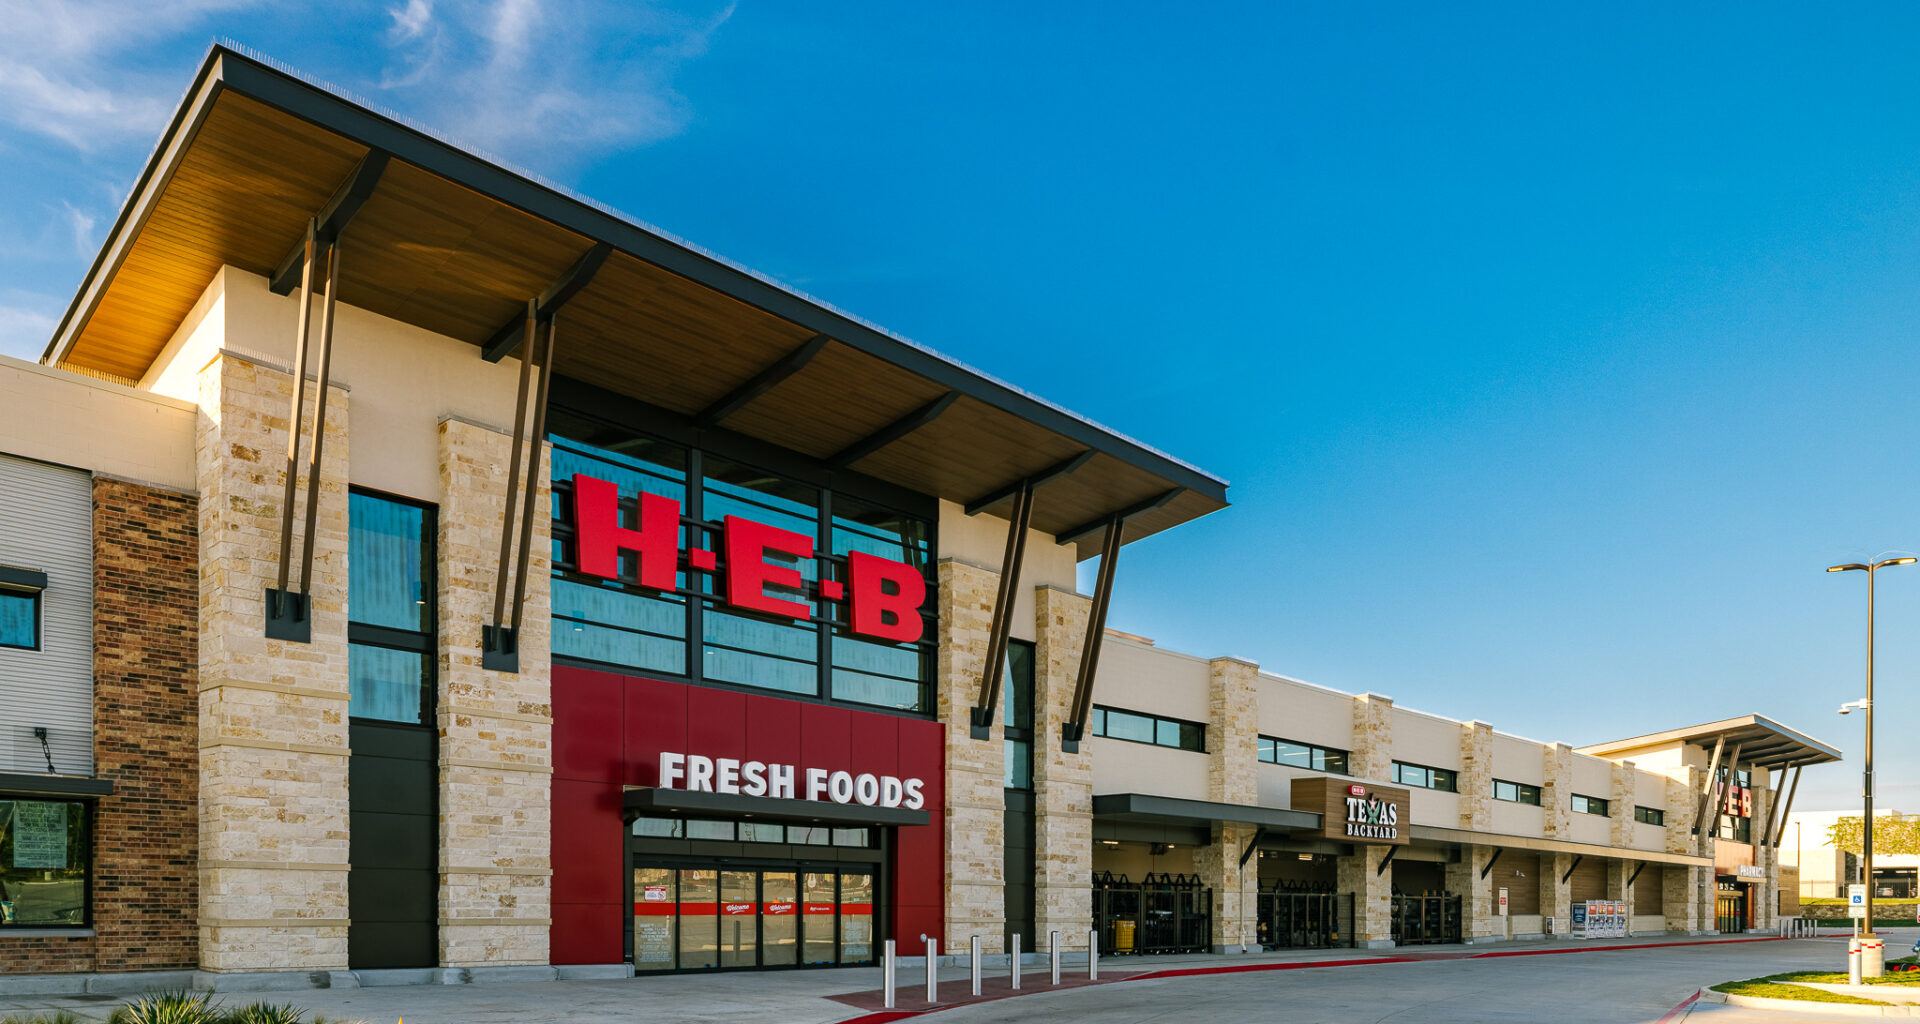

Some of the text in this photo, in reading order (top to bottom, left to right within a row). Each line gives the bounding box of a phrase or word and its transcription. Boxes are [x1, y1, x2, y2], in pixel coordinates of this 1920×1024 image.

[660, 751, 925, 810] FRESH FOODS
[1346, 797, 1397, 825] TEXAS
[1347, 824, 1397, 839] BACKYARD
